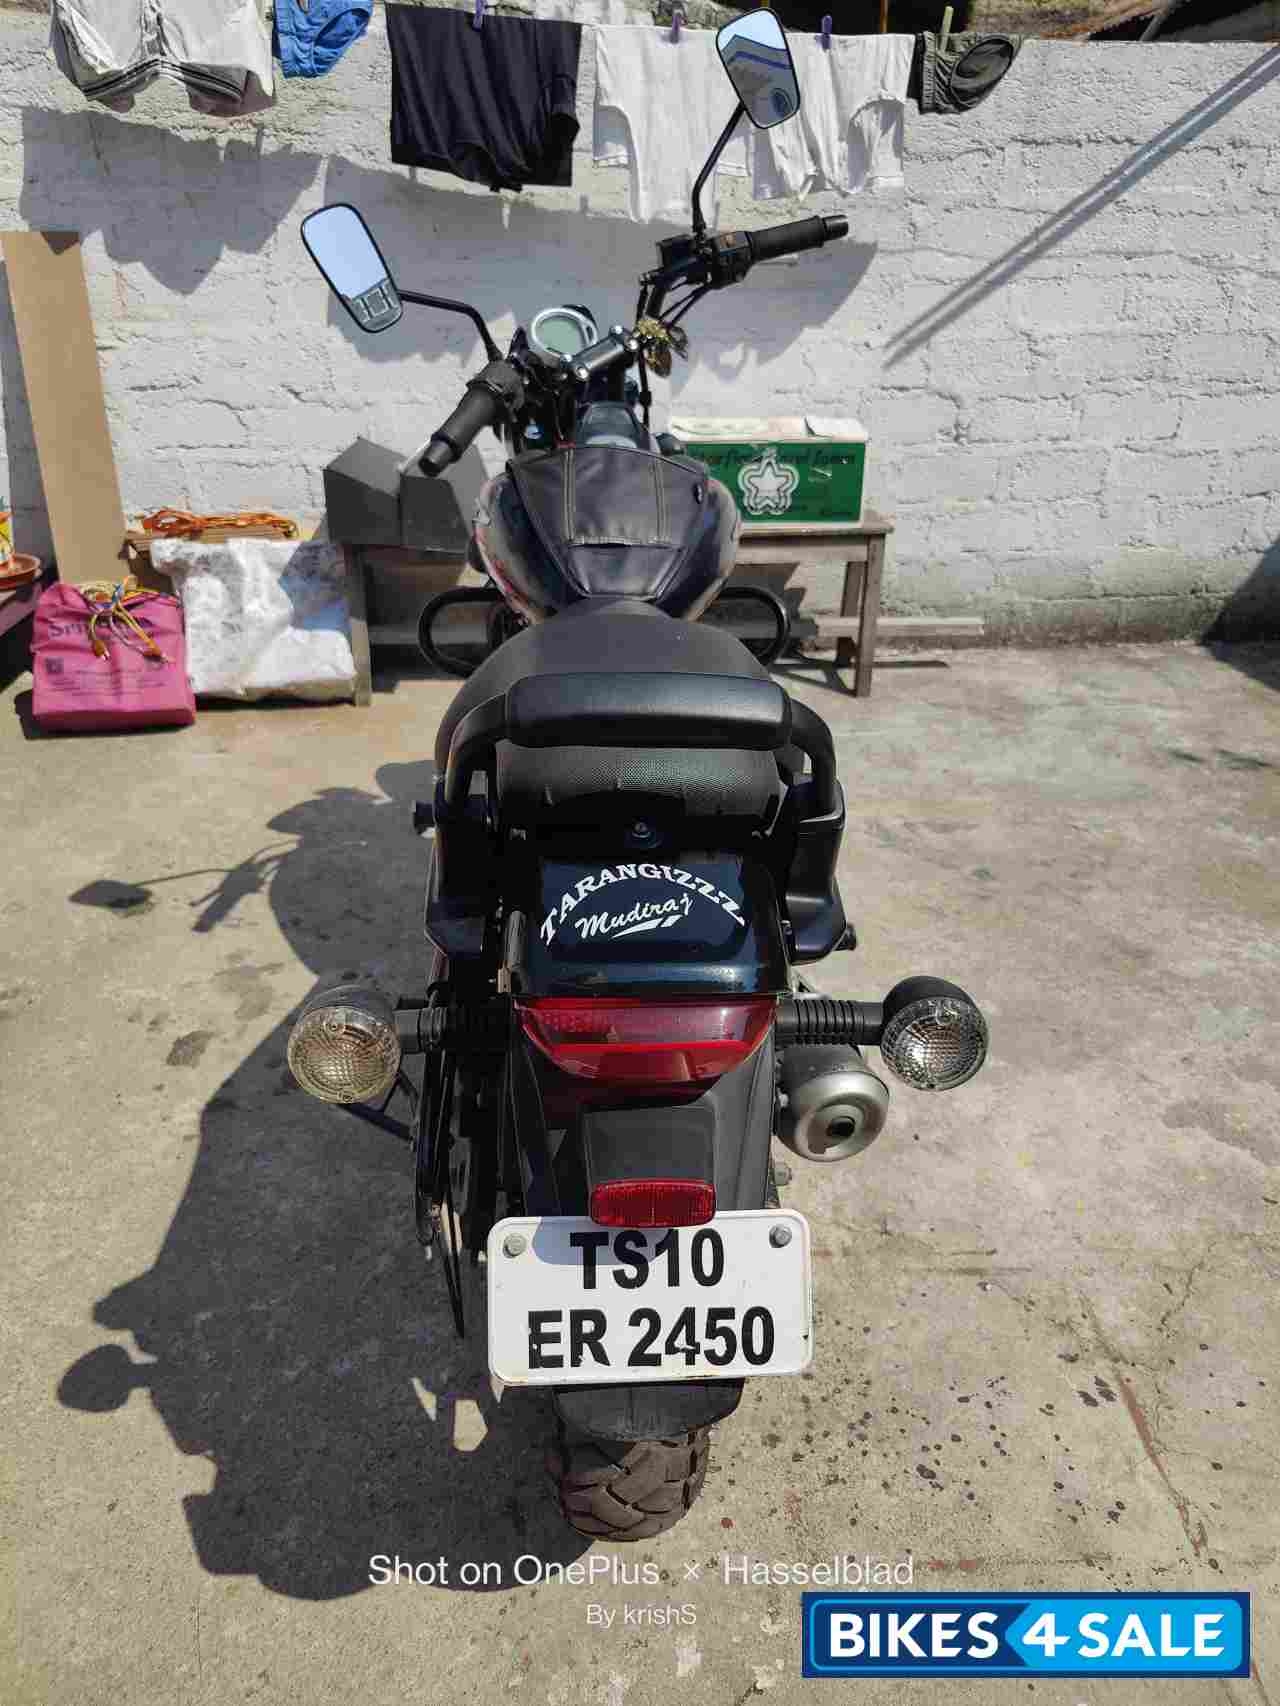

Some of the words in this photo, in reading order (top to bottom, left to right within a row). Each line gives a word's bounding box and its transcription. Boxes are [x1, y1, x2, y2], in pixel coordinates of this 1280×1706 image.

[569, 1227, 725, 1290] TS10
[528, 1308, 611, 1369] ER
[627, 1306, 775, 1367] 2450
